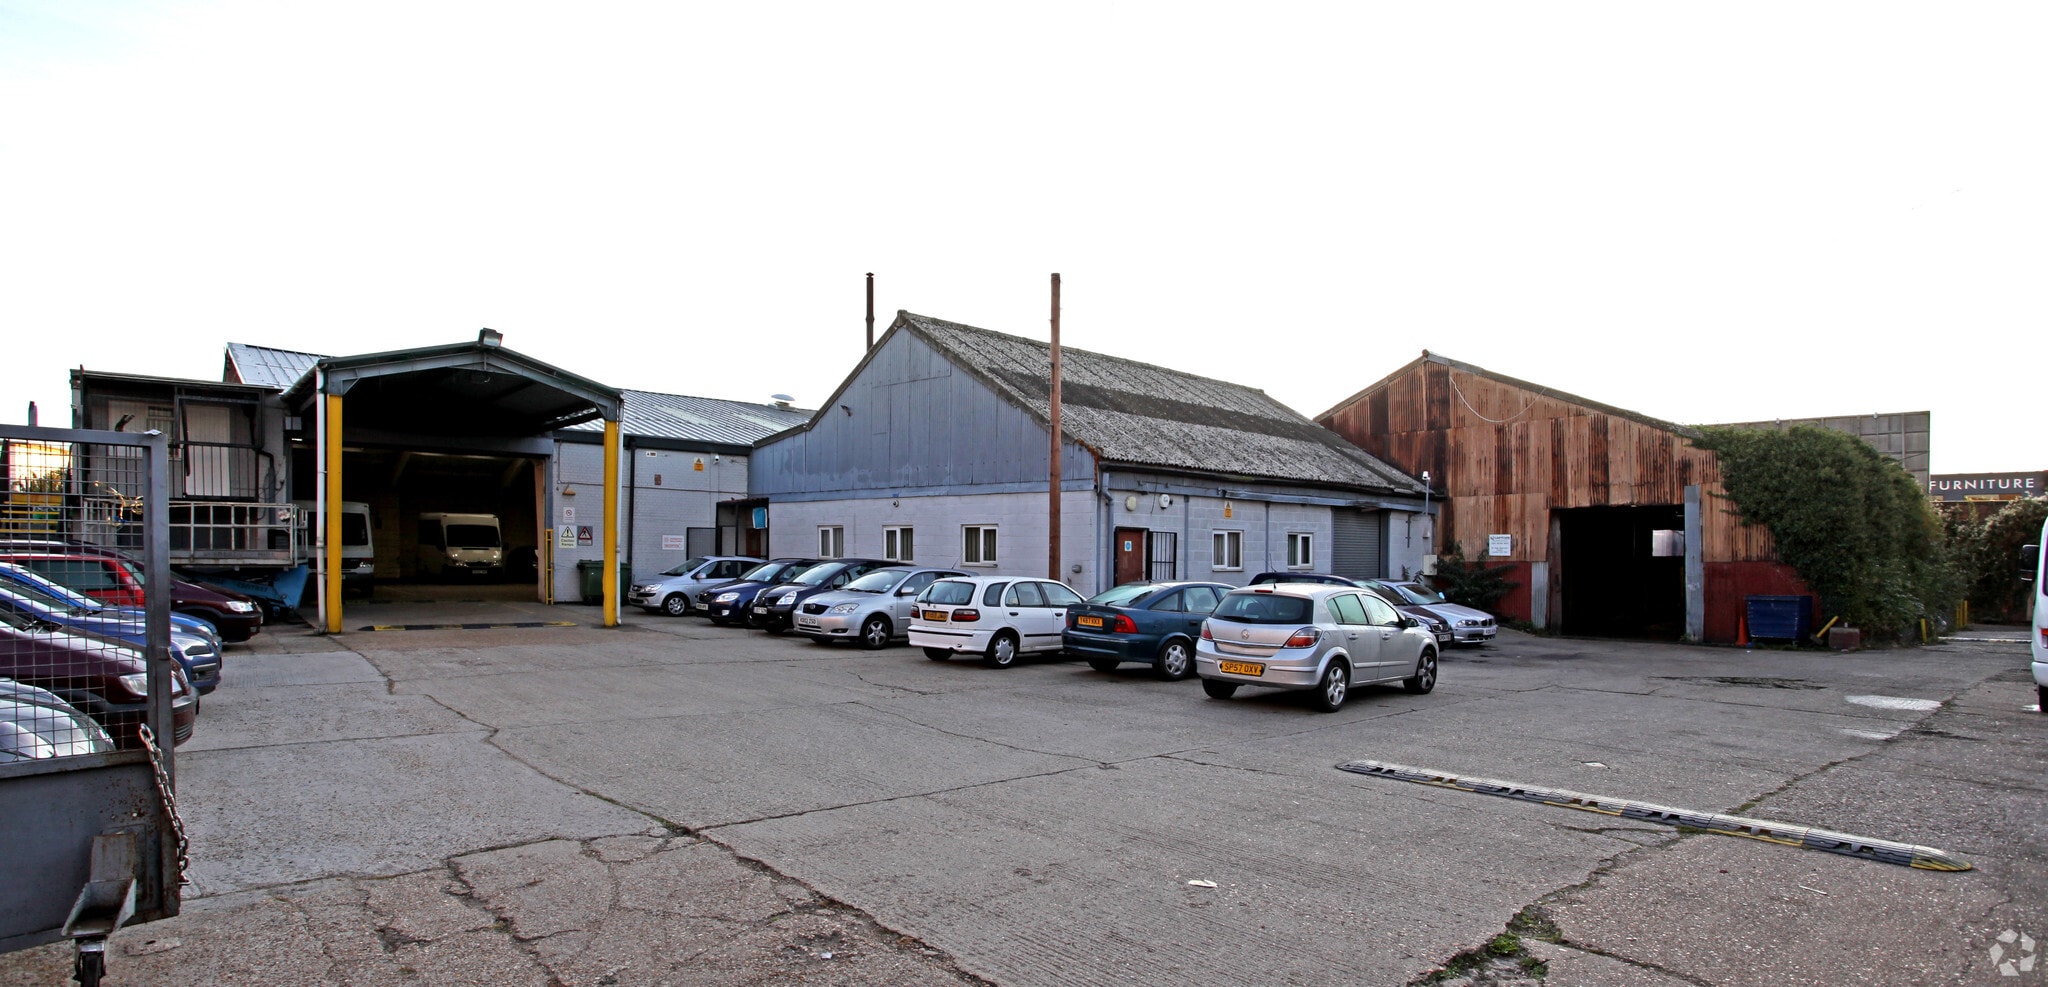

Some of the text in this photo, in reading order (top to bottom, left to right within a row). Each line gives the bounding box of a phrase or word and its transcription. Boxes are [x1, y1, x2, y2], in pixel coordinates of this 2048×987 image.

[1929, 478, 2035, 491] FURNITURE
[1224, 662, 1259, 674] SP57 OXV
